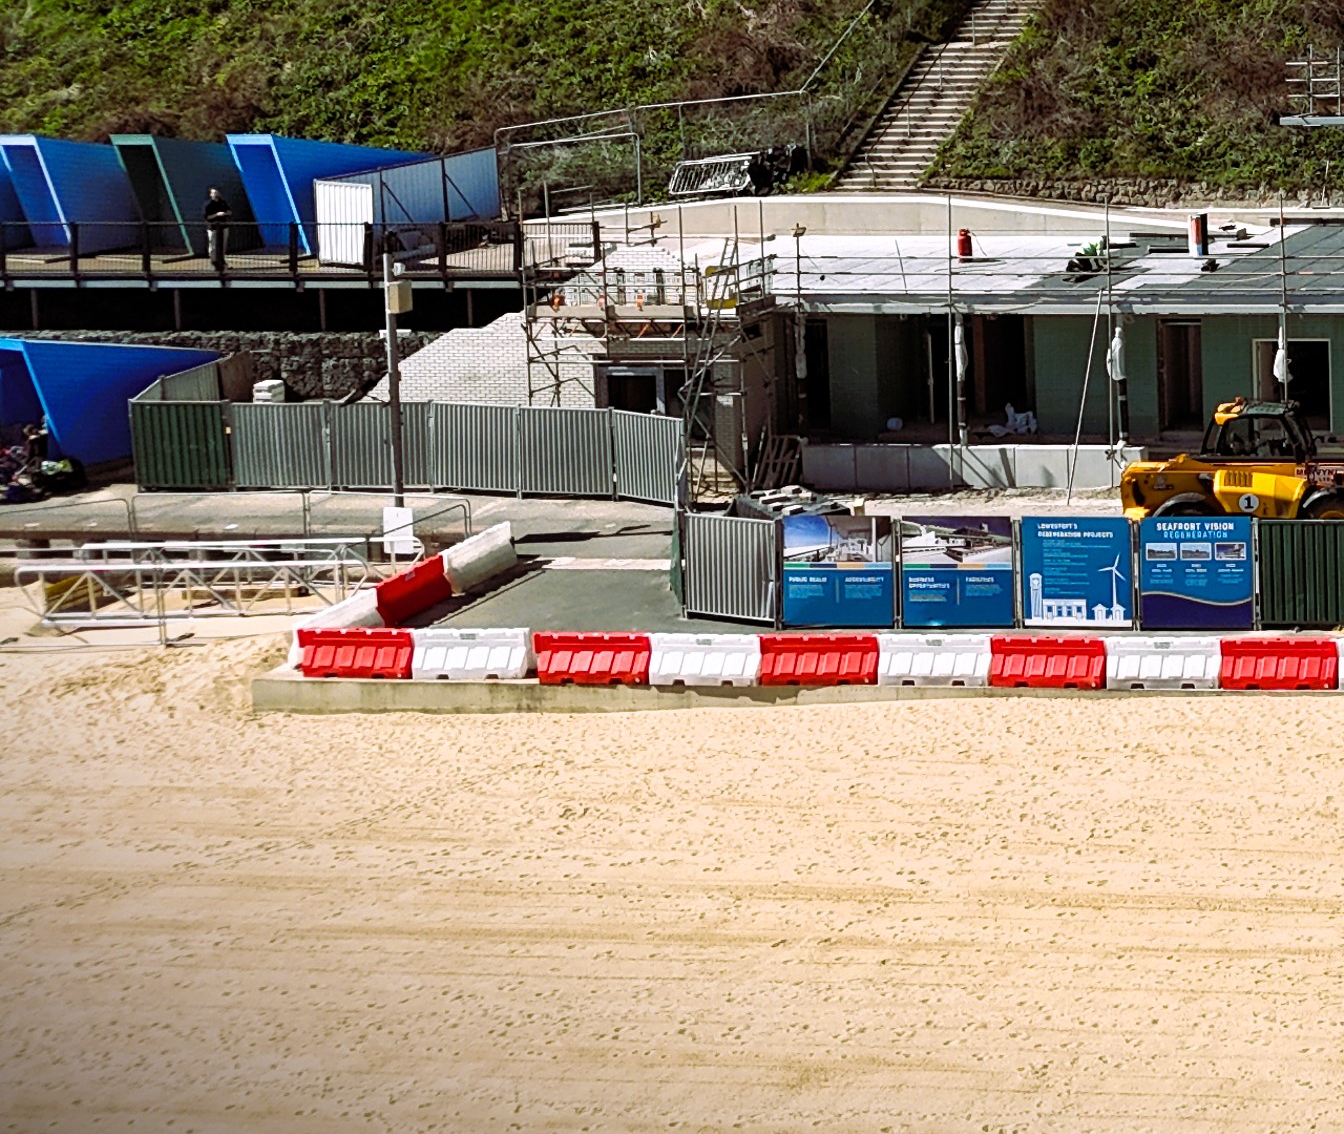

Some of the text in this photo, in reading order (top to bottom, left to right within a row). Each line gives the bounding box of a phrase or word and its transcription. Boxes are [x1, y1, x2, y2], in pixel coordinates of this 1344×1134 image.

[1243, 496, 1254, 509] 1
[1156, 522, 1235, 531] SEAFRONT VISION
[1163, 531, 1228, 539] REGENERATION
